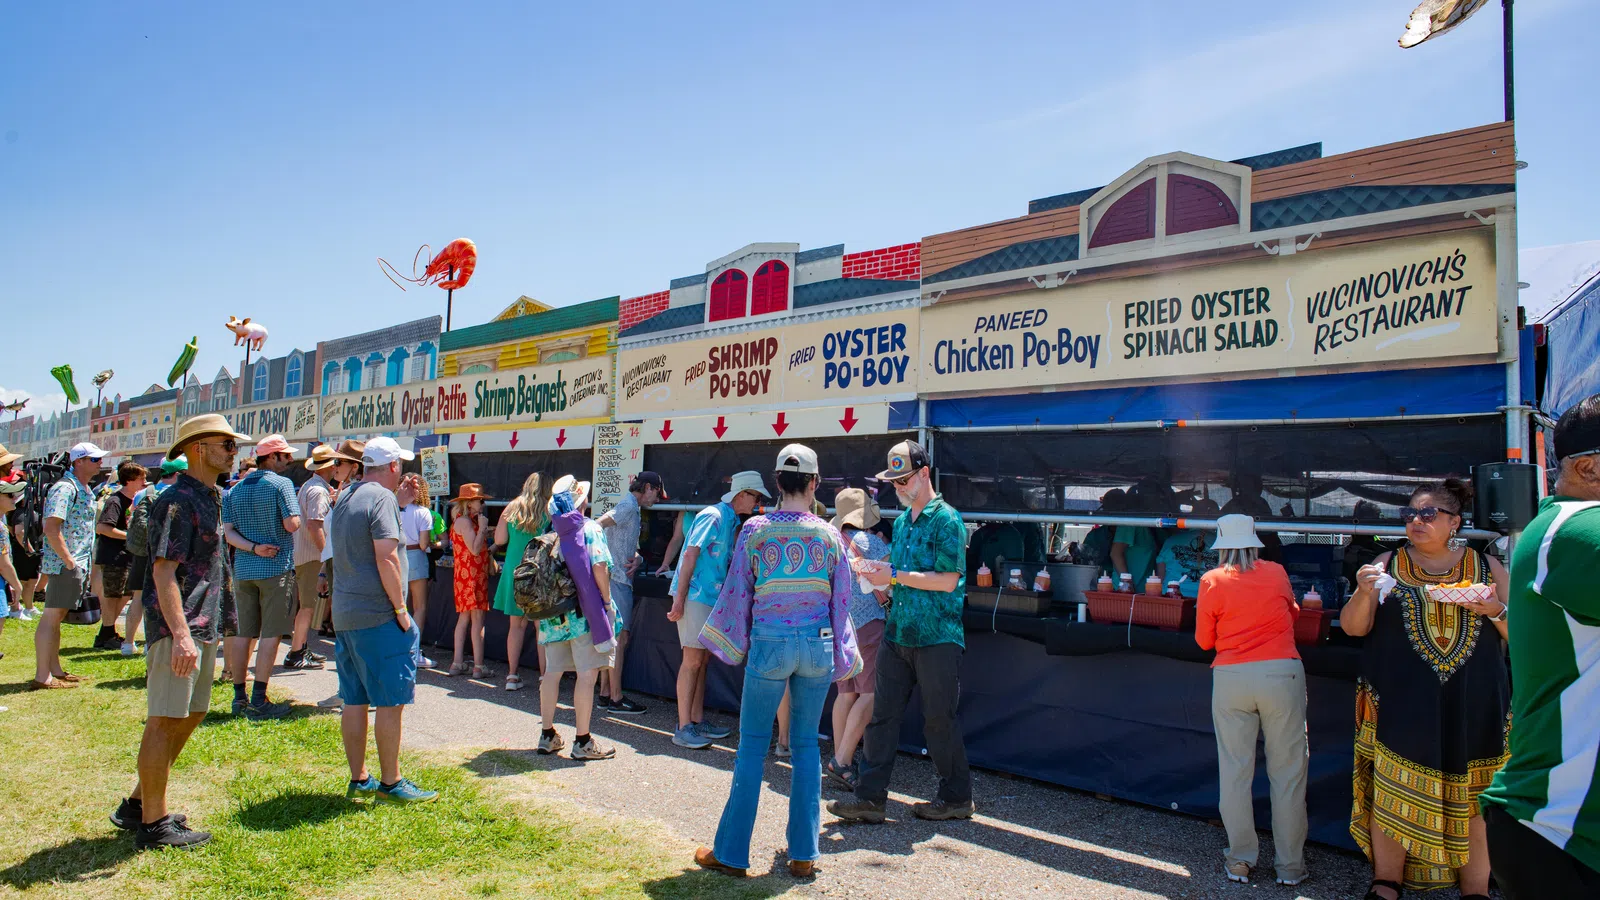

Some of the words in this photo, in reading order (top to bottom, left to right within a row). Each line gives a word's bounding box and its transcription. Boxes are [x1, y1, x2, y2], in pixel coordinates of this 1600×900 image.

[1307, 248, 1467, 324] VUCINOVICH'S
[974, 308, 1048, 334] PANEED
[1124, 297, 1182, 329] FRIED
[1191, 286, 1271, 321] OYSTER
[1313, 285, 1473, 355] RESTAURANT
[708, 336, 778, 373] SHRIMP
[822, 323, 907, 361] OYSTER
[934, 336, 1014, 375] Chicken
[1023, 328, 1101, 369] Po-Boy
[1123, 325, 1207, 360] SPINACH
[1214, 318, 1279, 352] SALAD
[622, 354, 667, 388] VUCINOVICH'S
[684, 360, 706, 386] FRIED
[788, 345, 816, 371] FRIED
[824, 354, 910, 389] PO-BOY
[474, 379, 516, 420] Shrimp
[516, 370, 567, 422] Beignets
[569, 384, 596, 407] CATERING
[573, 369, 603, 390] PATTON'S
[626, 370, 672, 400] RESTAURANT
[709, 368, 772, 400] PO-BOY
[236, 411, 256, 435] LAIT
[259, 406, 290, 434] PO-BOY
[342, 395, 374, 430] Crawfish
[375, 392, 395, 427] Sack
[401, 388, 434, 430] Oyster
[437, 384, 466, 422] Pattie
[598, 454, 626, 462] OYSTER
[601, 487, 621, 495] SALAD
